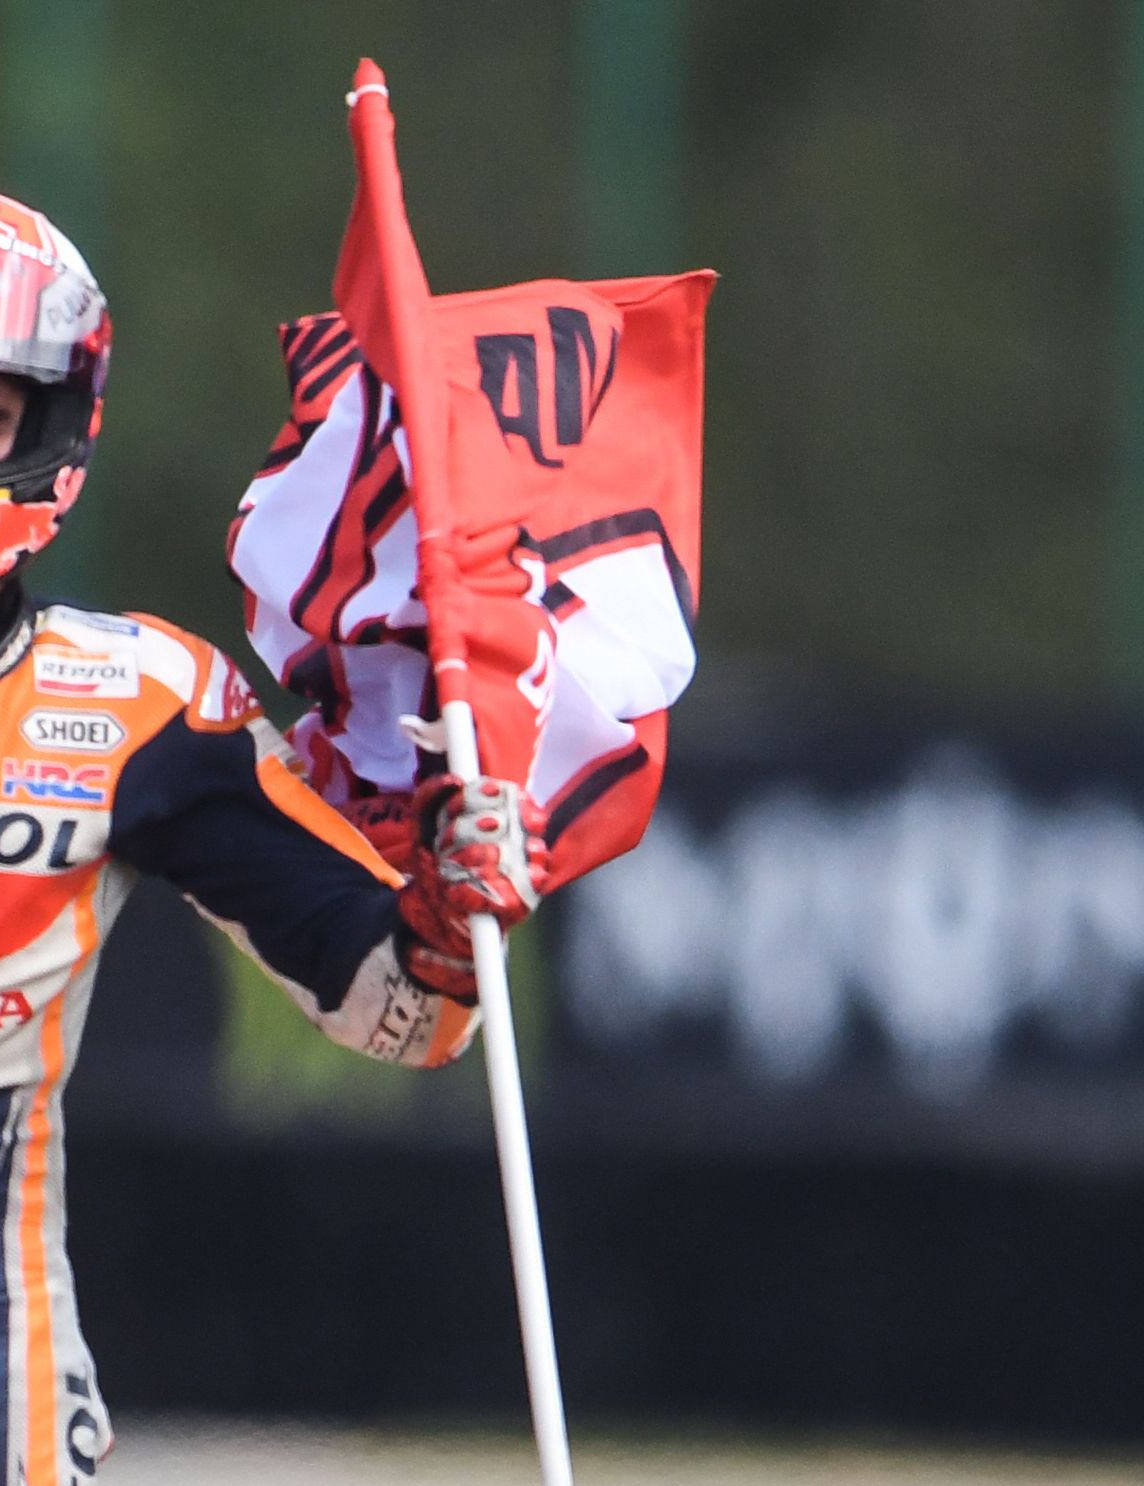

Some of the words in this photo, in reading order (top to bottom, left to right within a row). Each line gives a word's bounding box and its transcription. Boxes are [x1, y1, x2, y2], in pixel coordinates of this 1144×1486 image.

[42, 658, 128, 680] REPSOL
[36, 717, 110, 745] SHOEI
[2, 758, 110, 800] HRC
